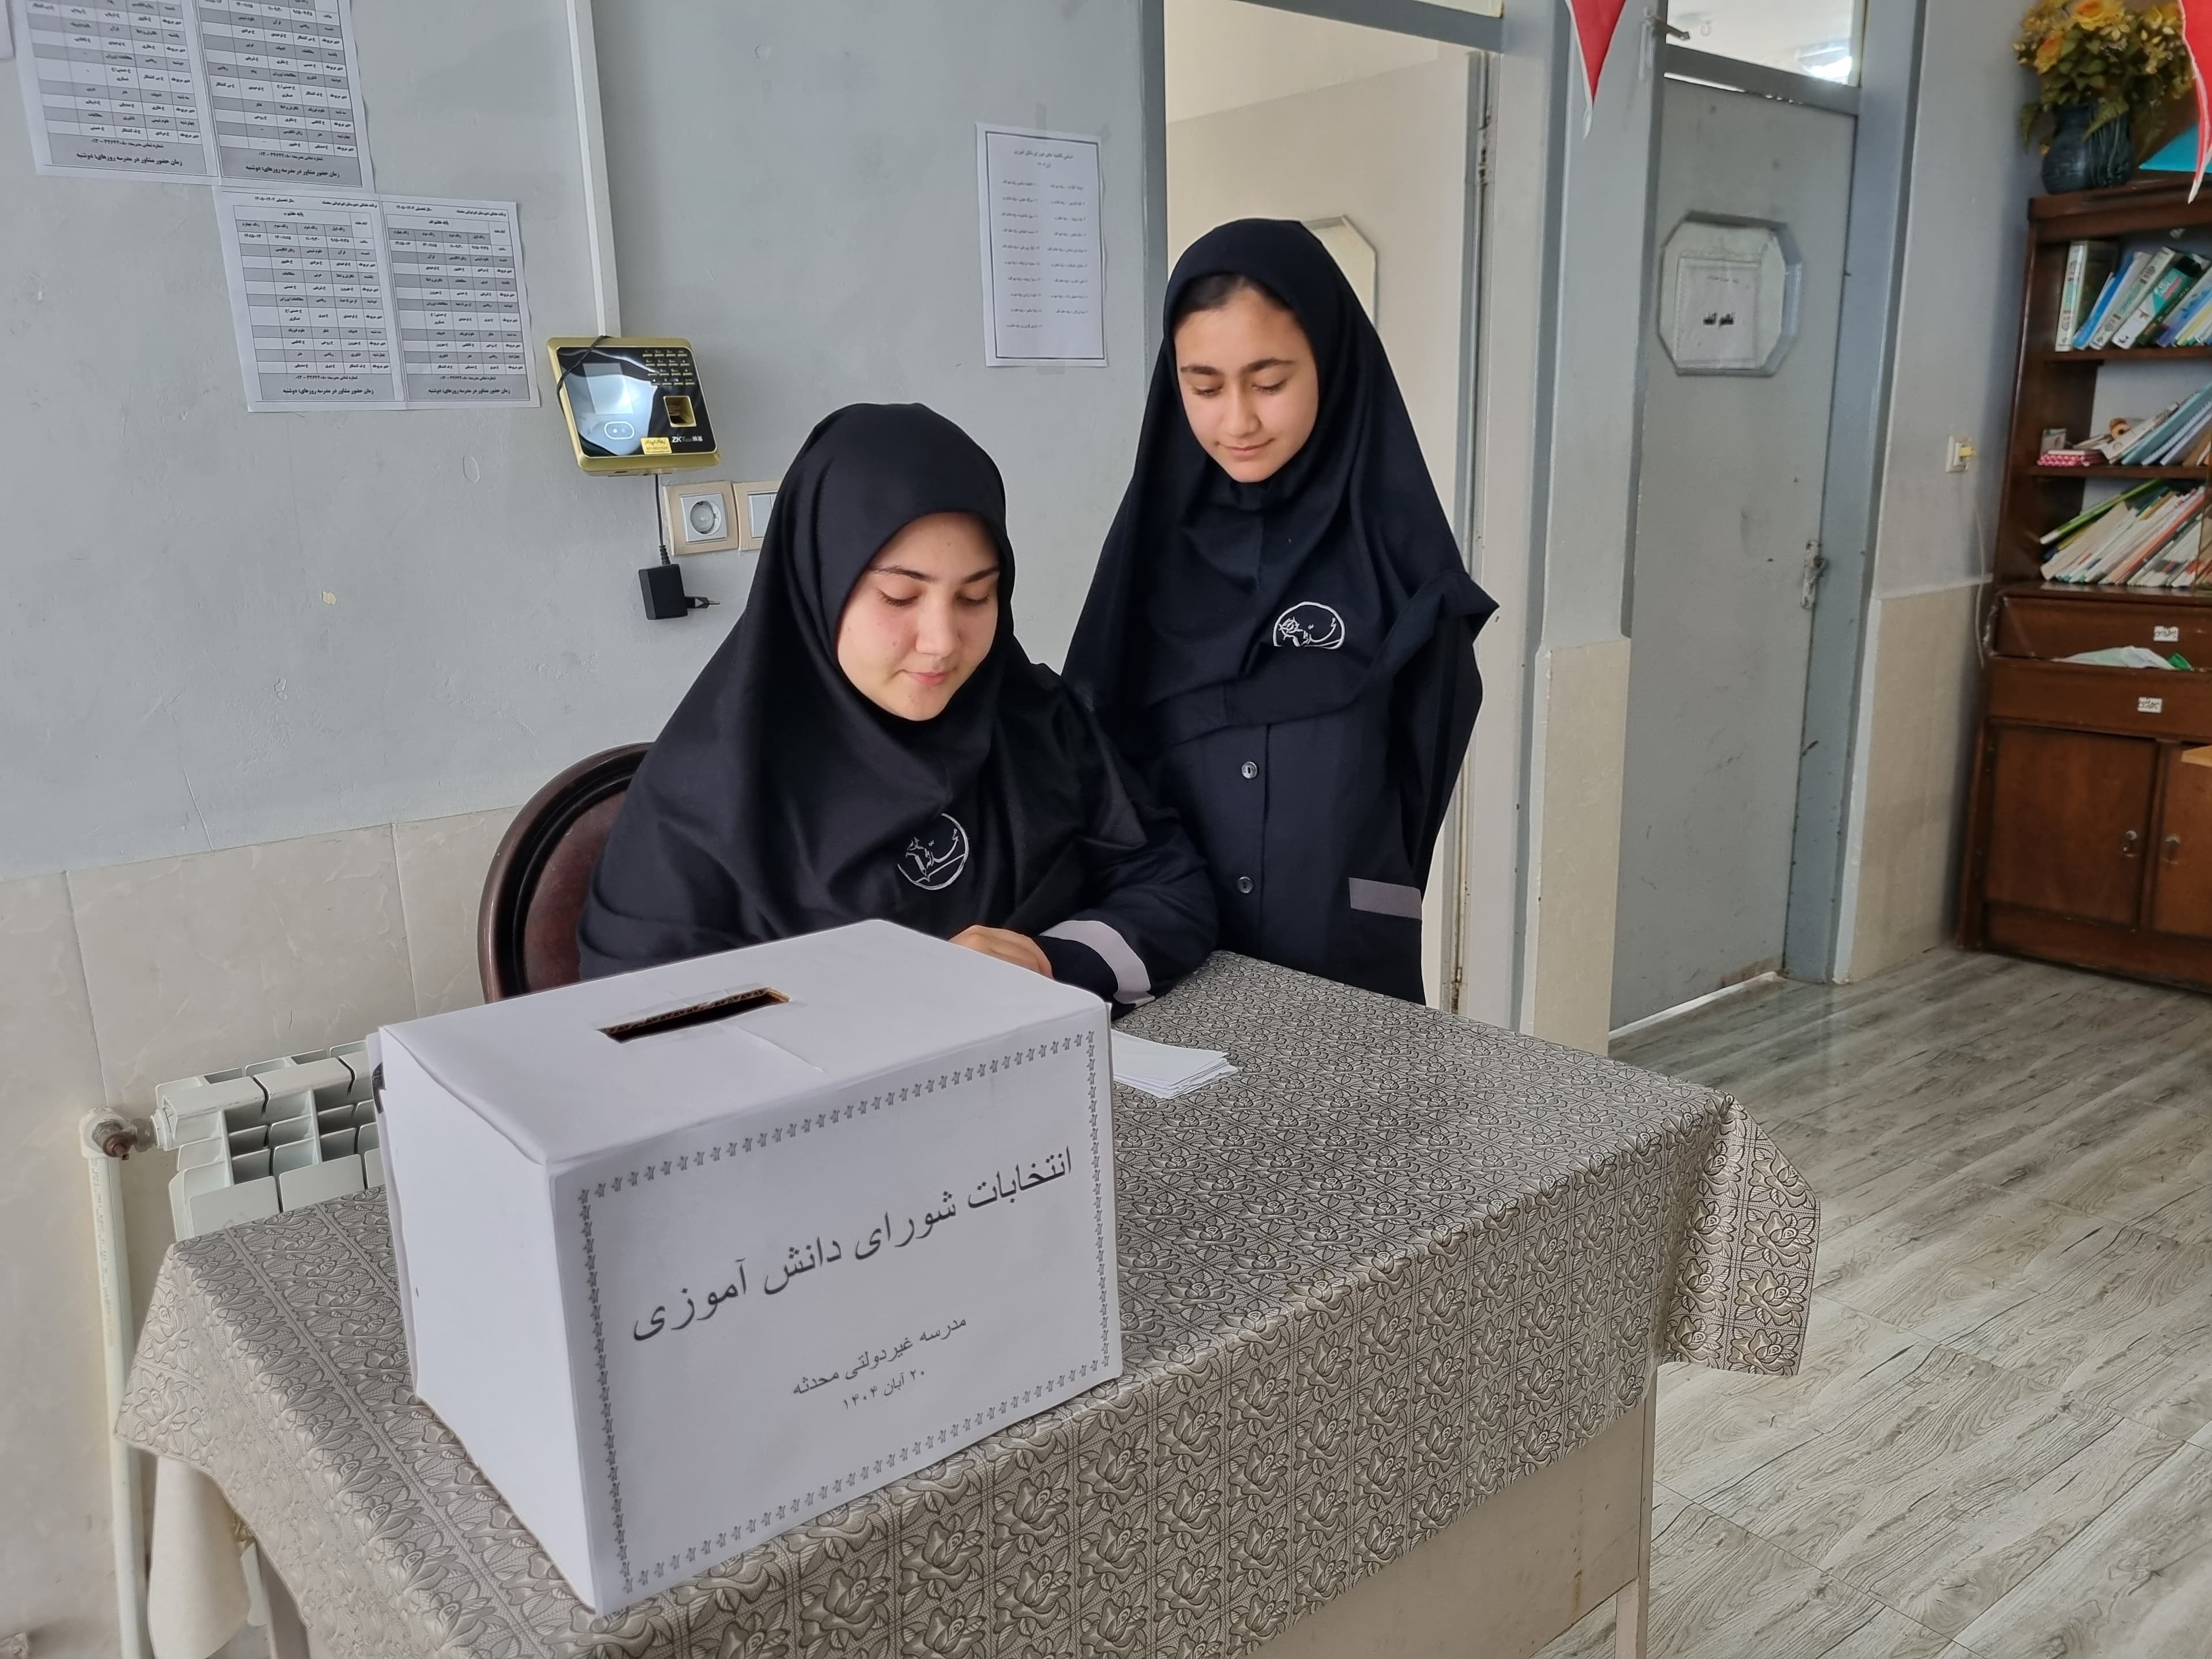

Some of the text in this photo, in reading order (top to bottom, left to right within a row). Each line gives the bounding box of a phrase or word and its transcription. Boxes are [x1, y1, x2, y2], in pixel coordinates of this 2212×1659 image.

[634, 1146, 1071, 1341] انتخابات شورای دانش آموزی
[793, 1319, 966, 1394] مدرسه غیردولتی محدثه
[844, 1369, 924, 1409] ۲۰ آبان ۱۴۰۴
